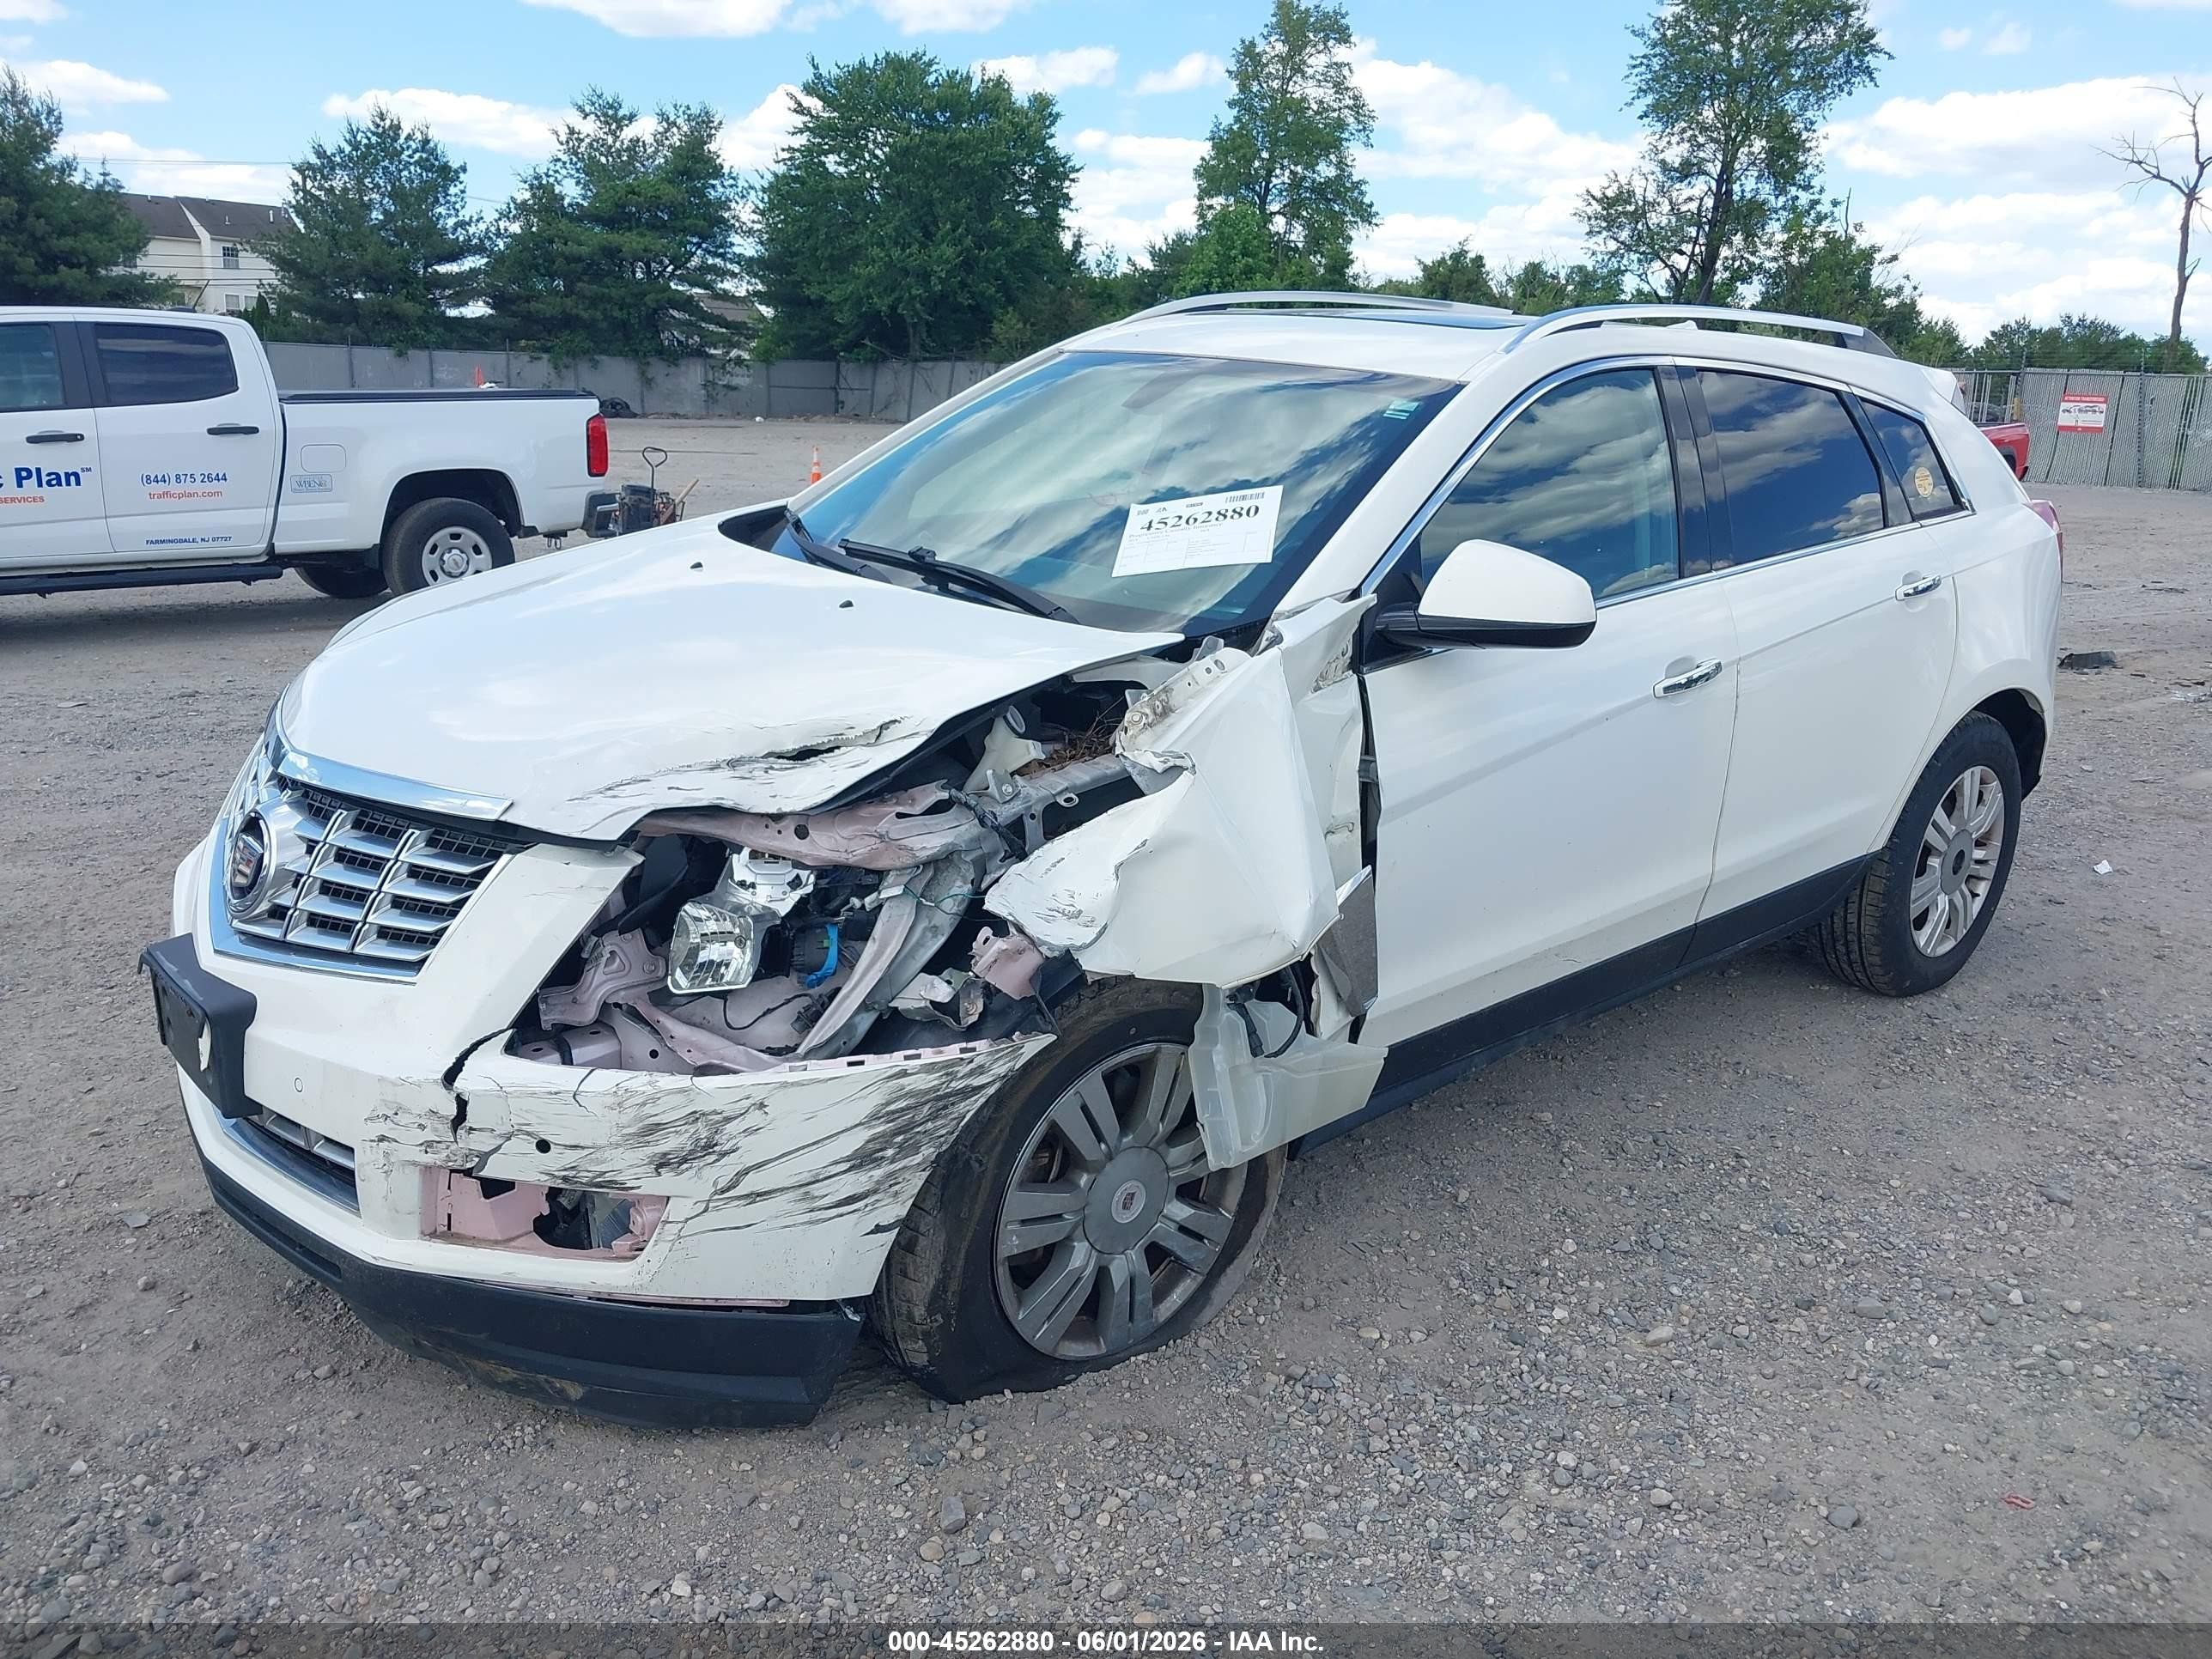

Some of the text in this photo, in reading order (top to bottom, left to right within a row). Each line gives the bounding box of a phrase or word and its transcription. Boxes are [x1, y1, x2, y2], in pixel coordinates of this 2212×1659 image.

[15, 467, 82, 488] Plan
[141, 472, 228, 487] (844) 875 2644
[149, 490, 223, 500] trafficplan.com
[1140, 505, 1260, 531] 45262880
